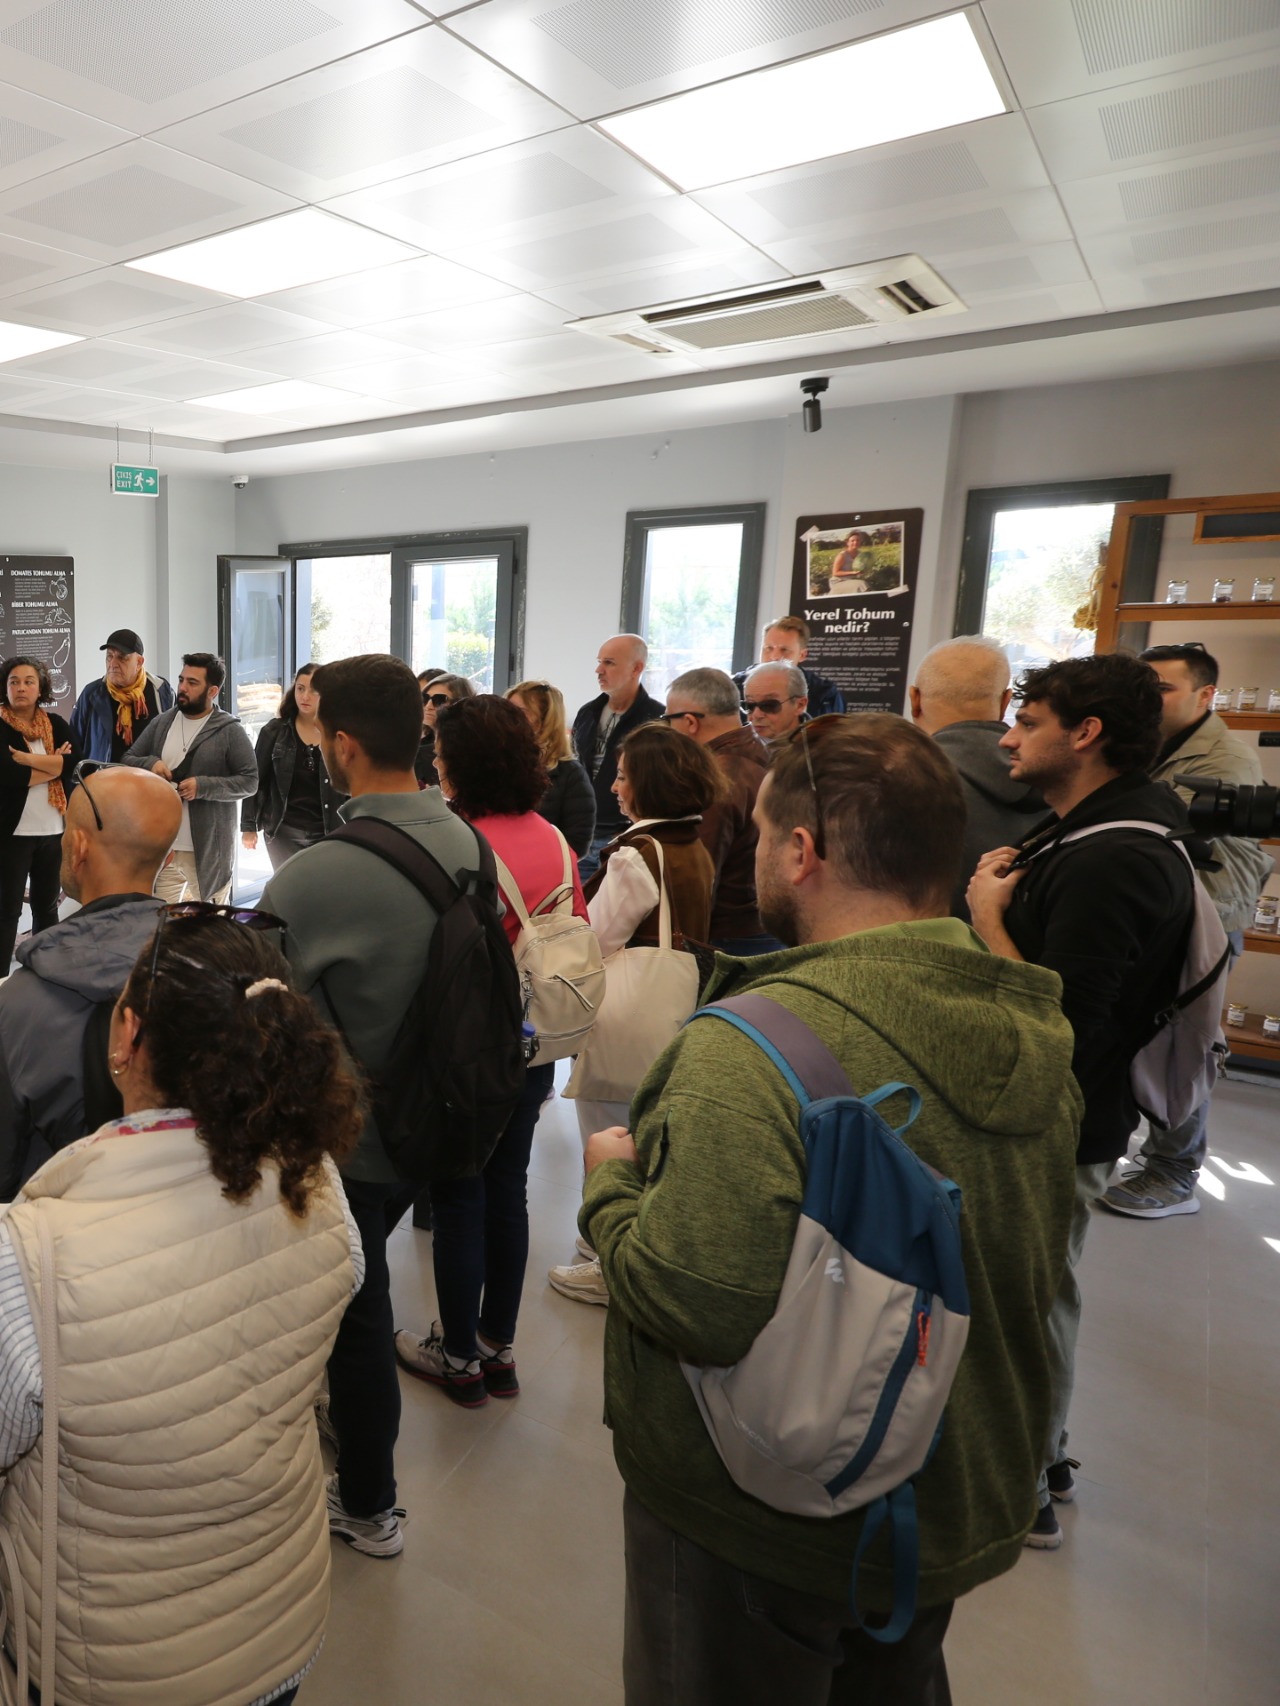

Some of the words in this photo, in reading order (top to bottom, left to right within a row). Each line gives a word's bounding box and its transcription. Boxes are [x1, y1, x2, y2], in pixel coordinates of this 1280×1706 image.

[116, 471, 132, 480] ÇIKIŞ
[116, 480, 132, 488] EXIT
[11, 600, 24, 608] BİBER
[804, 608, 841, 621] Yerel
[844, 607, 895, 620] Tohum
[824, 620, 871, 633] nedir?
